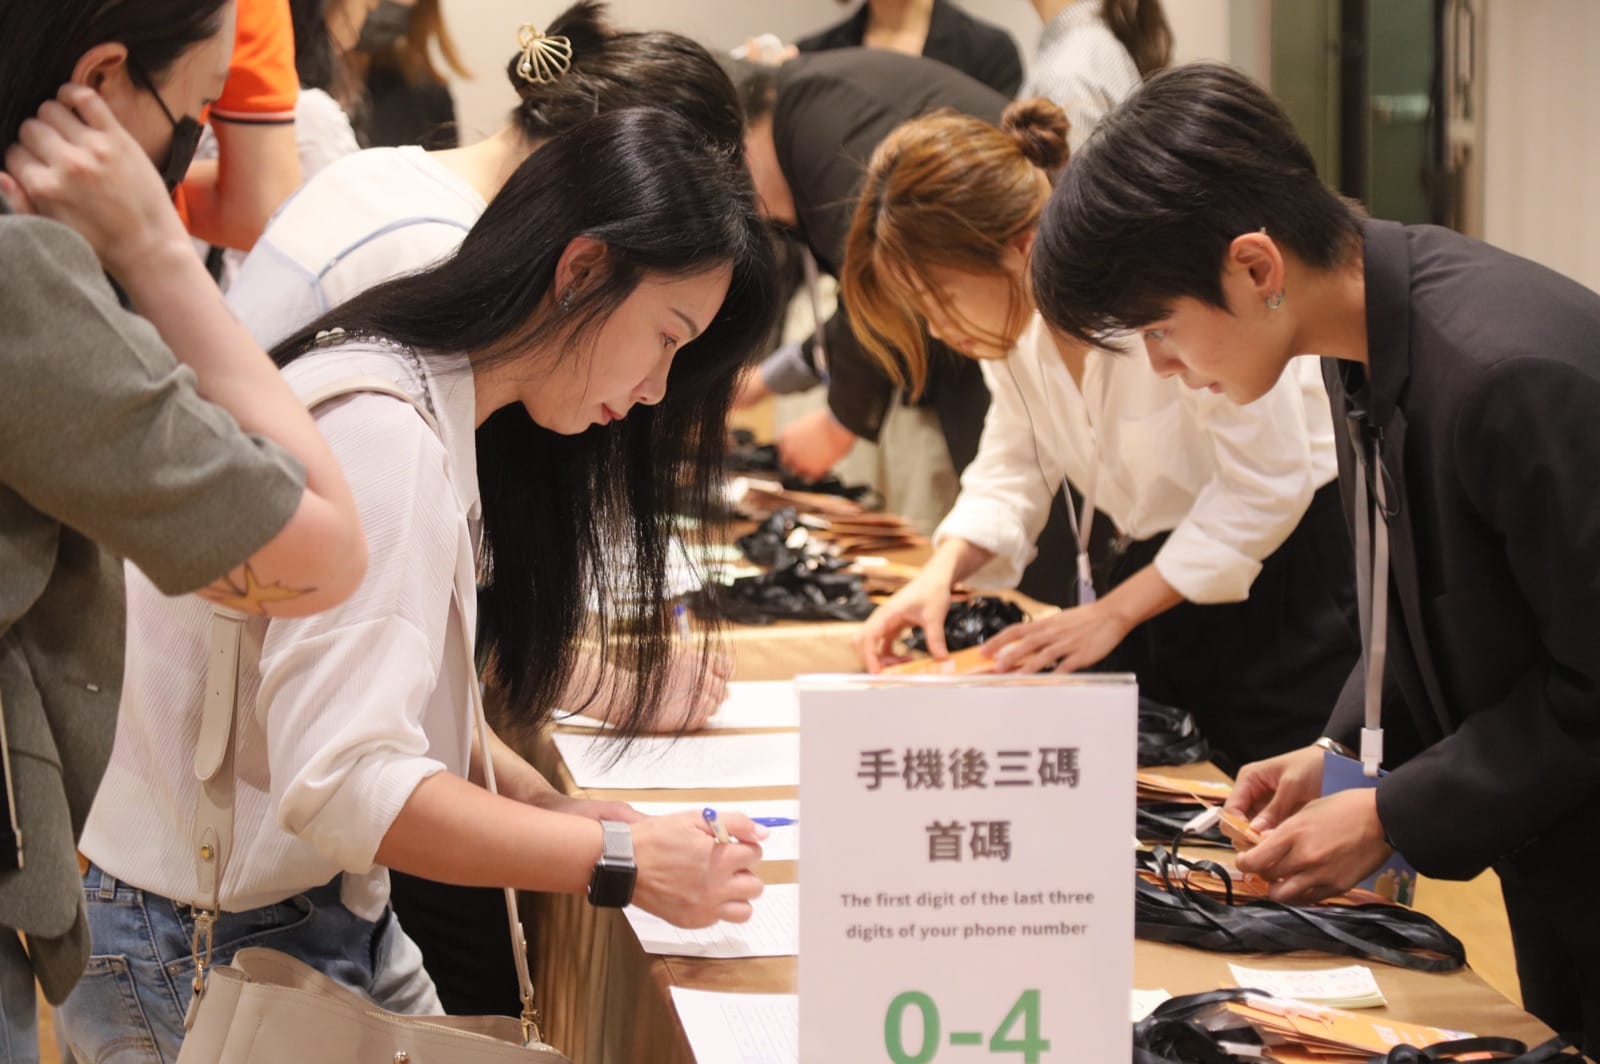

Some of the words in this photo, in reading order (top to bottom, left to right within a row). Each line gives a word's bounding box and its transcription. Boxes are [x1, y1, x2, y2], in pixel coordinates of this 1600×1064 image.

[857, 747, 1080, 791] 手機後三碼
[925, 820, 1013, 862] 首碼
[841, 893, 872, 907] The
[876, 892, 912, 907] first
[916, 891, 955, 909] digit
[959, 891, 978, 906] of
[981, 891, 1009, 905] the
[1013, 891, 1044, 905] last
[1048, 891, 1095, 905] three
[846, 924, 894, 941] digits
[898, 924, 916, 938] of
[920, 925, 959, 941] your
[963, 923, 1017, 941] phone
[1021, 922, 1088, 937] number
[884, 988, 1051, 1064] 0-4
